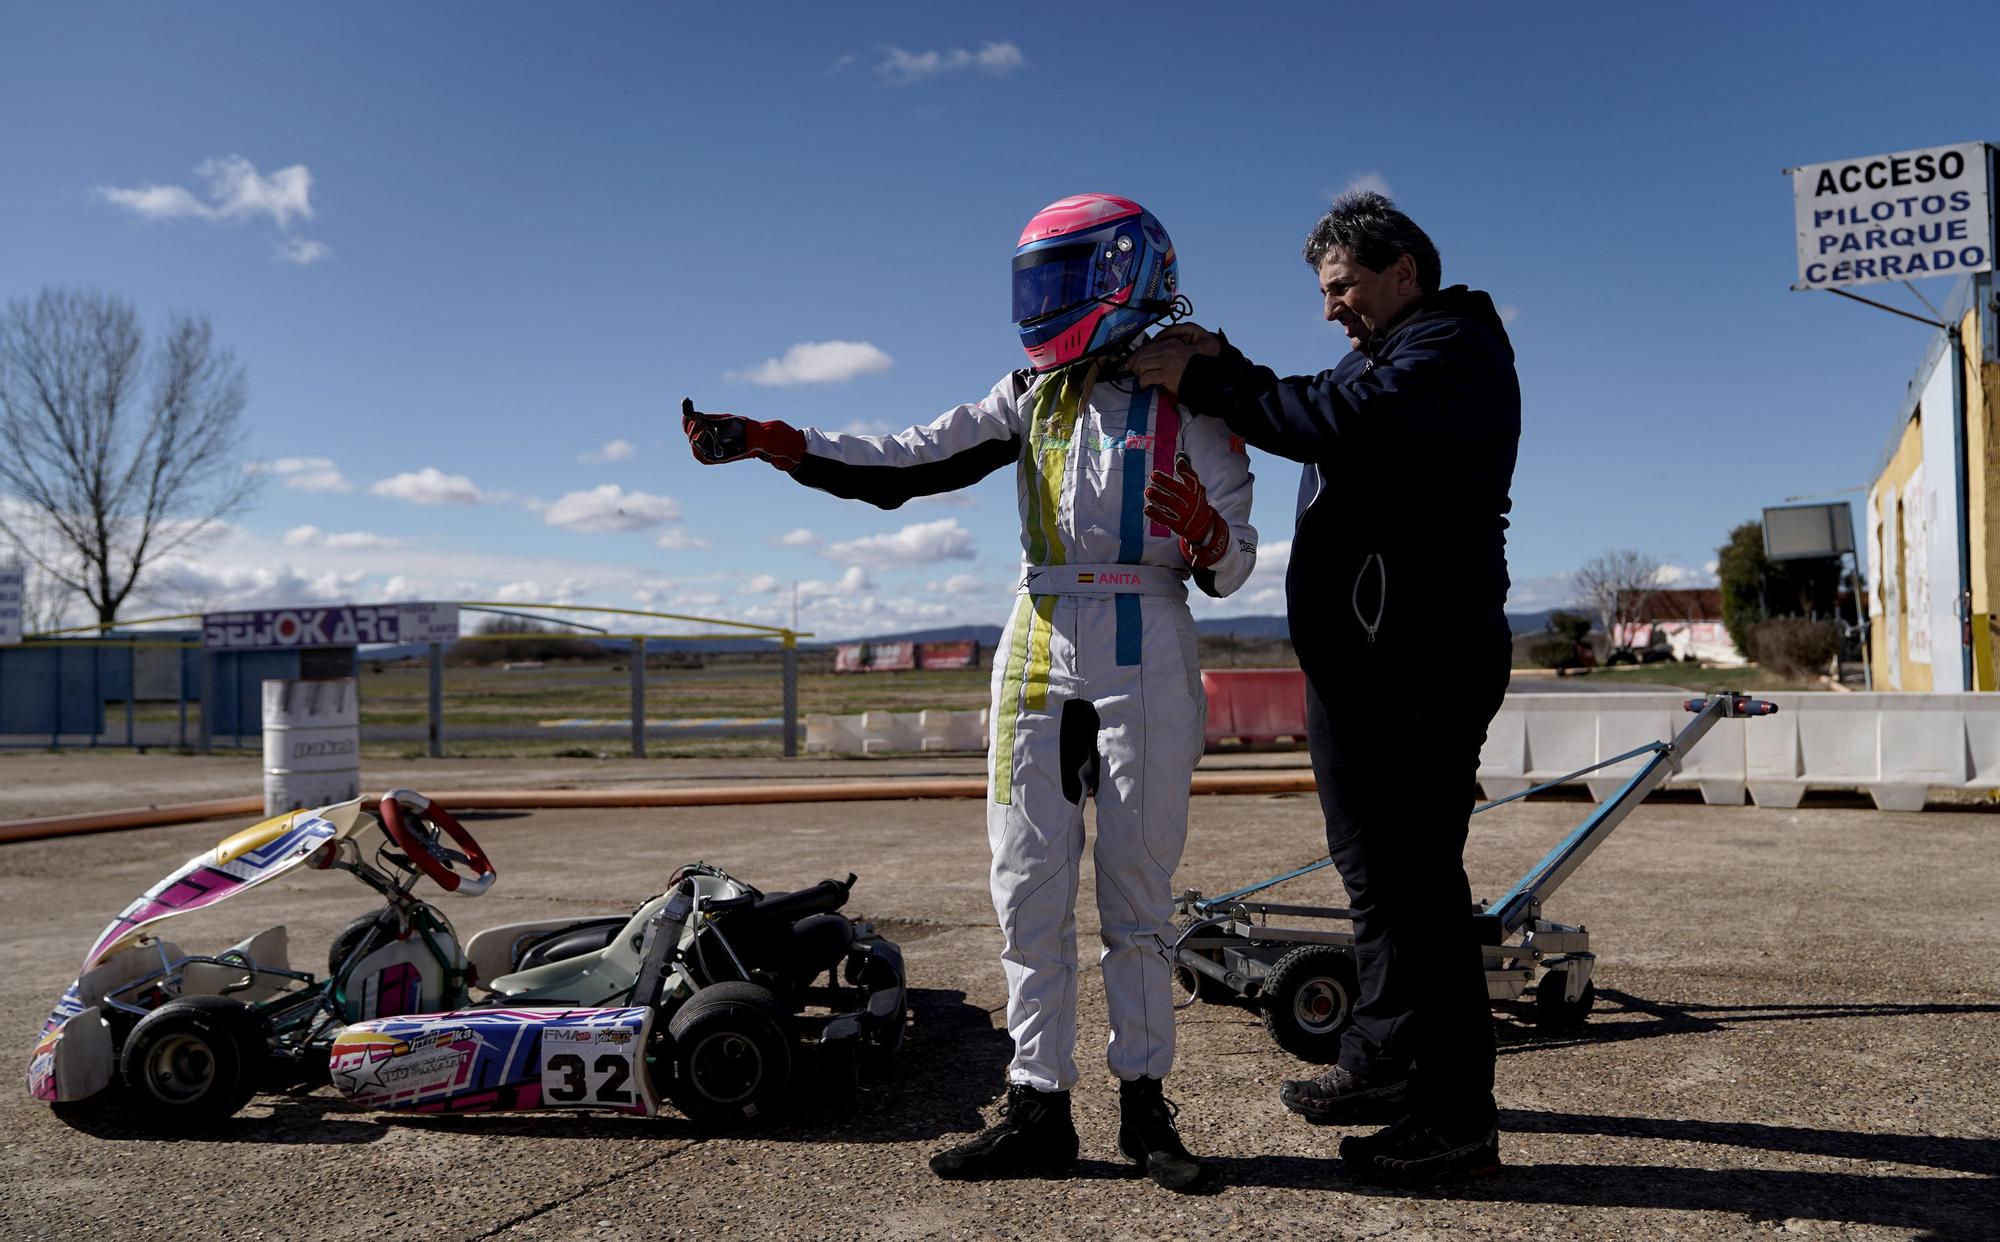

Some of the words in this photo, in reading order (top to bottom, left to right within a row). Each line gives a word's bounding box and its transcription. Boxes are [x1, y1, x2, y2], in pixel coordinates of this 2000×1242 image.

[1815, 151, 1964, 197] ACCESO
[1814, 191, 1970, 228] PILOTOS
[1820, 219, 1968, 255] PARQUE
[1806, 246, 1985, 283] CERRADO
[1099, 574, 1140, 585] ANITA
[547, 1054, 632, 1104] 32
